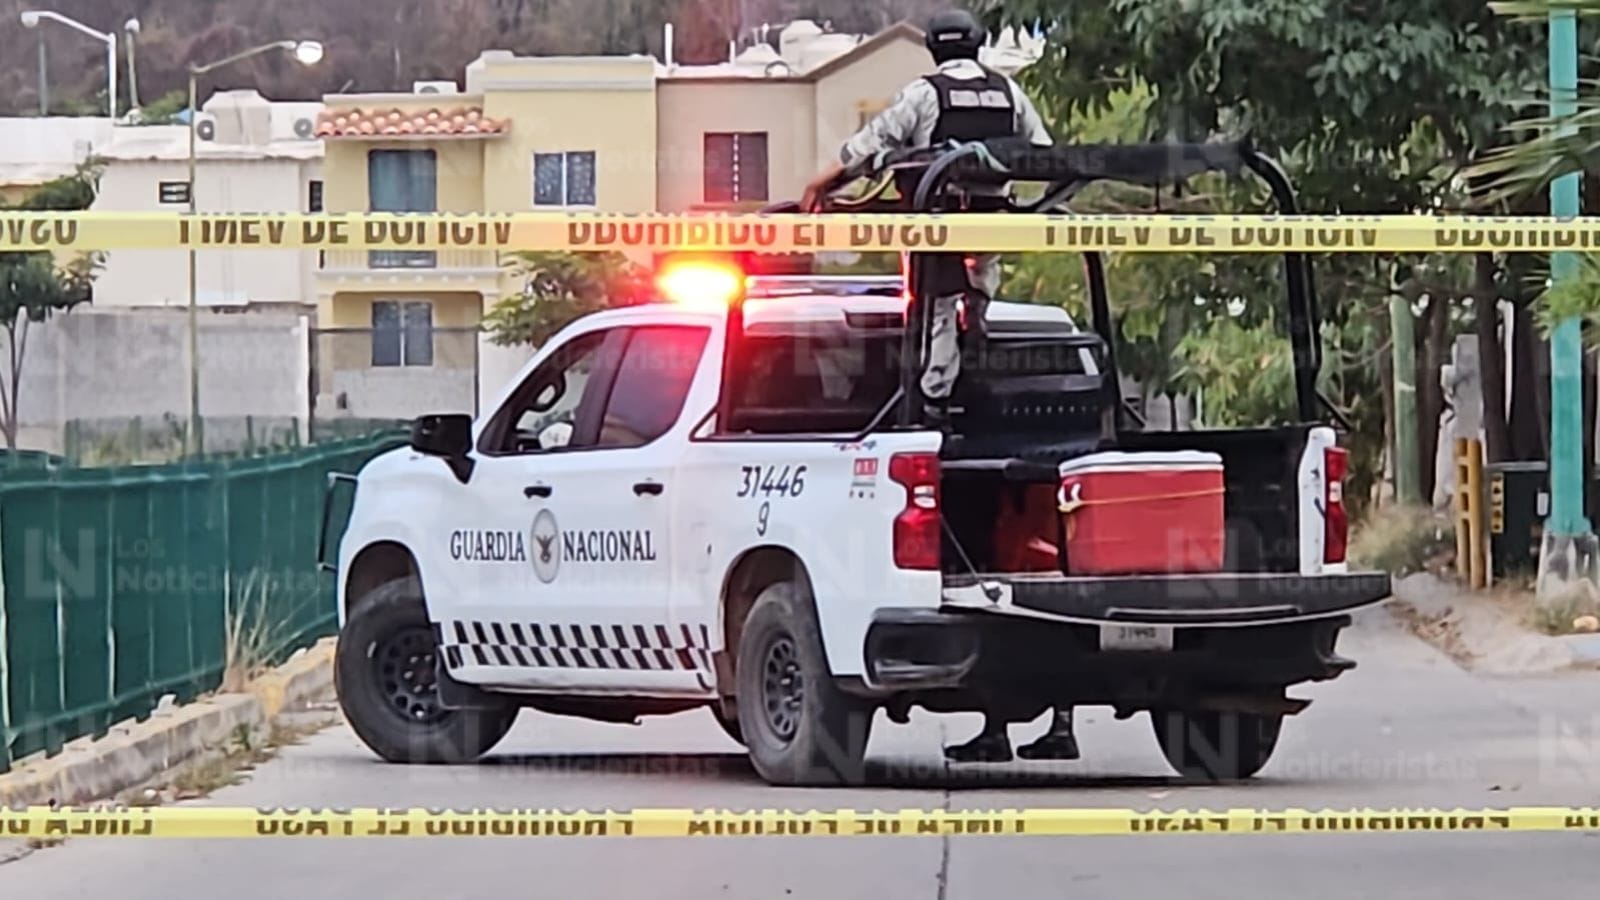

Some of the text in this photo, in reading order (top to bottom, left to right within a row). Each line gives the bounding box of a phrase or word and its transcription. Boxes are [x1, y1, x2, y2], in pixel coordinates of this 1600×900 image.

[737, 465, 807, 498] 31446
[757, 502, 770, 537] 9
[450, 530, 657, 562] GUARDIA NACIONAL
